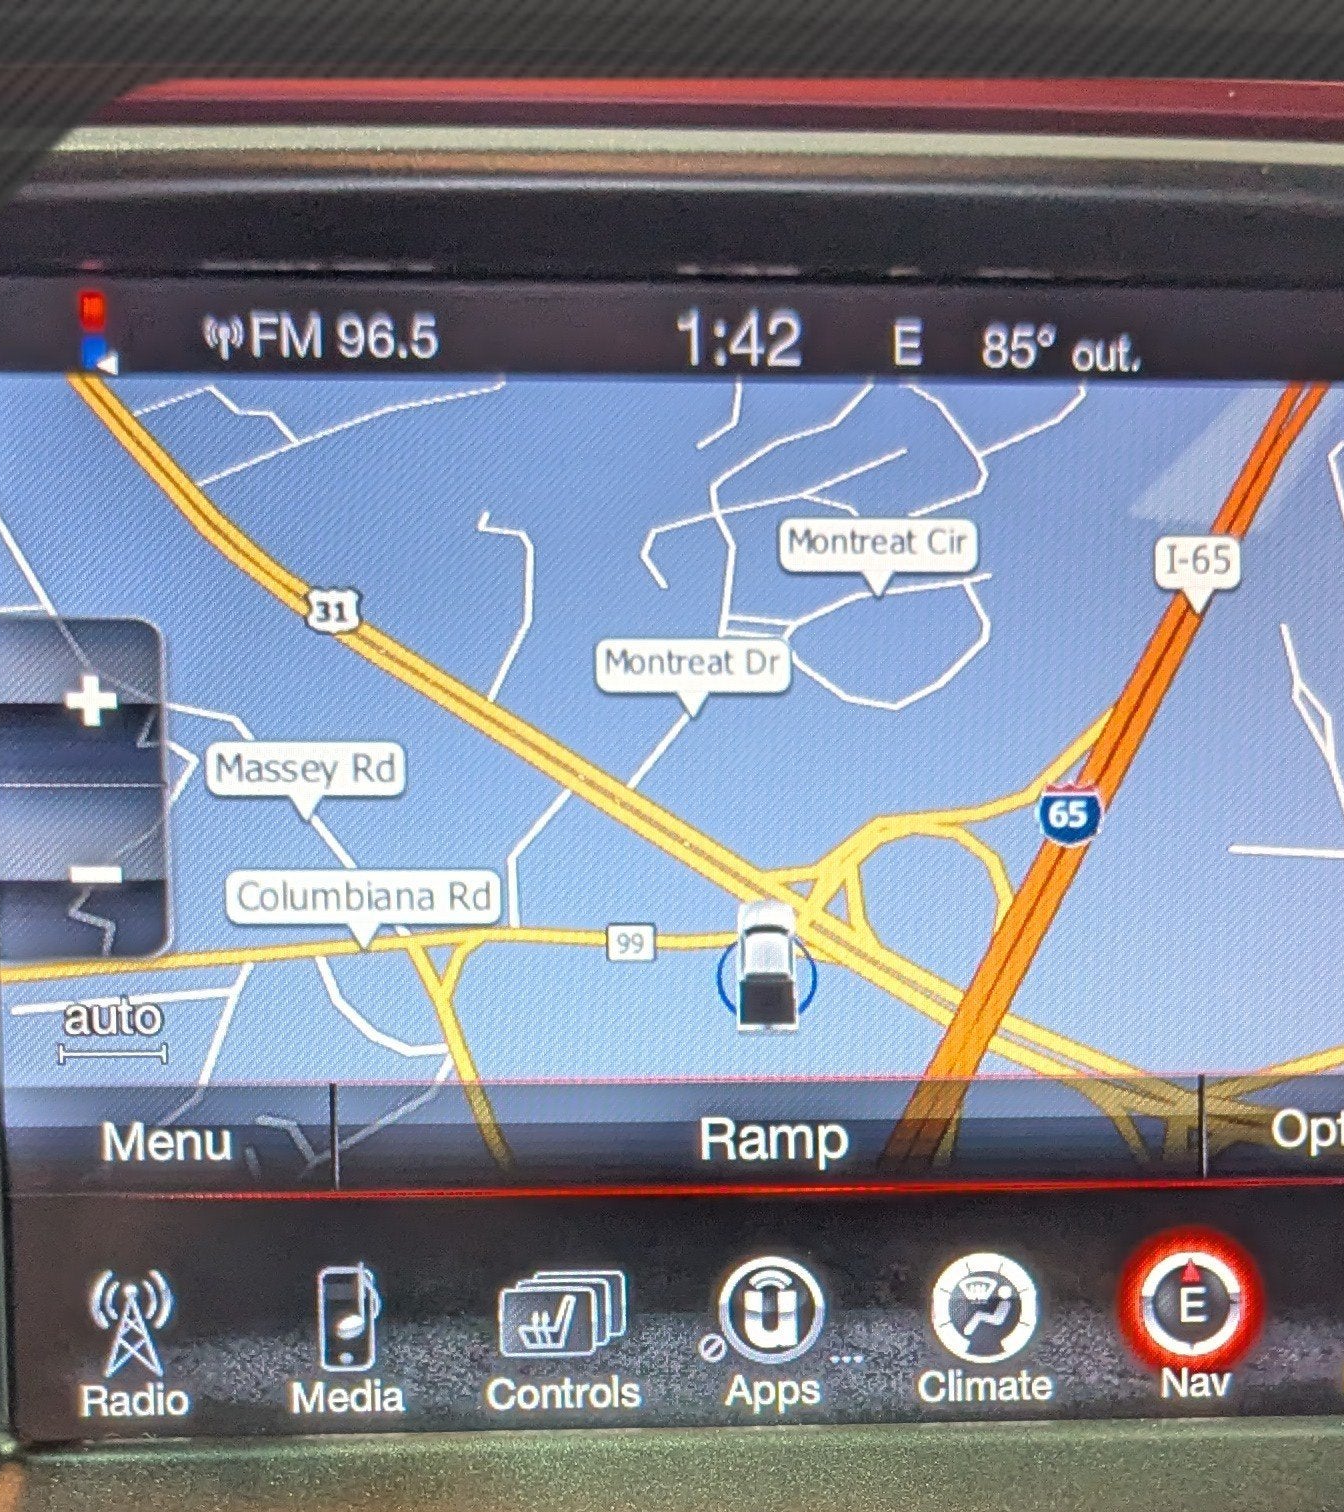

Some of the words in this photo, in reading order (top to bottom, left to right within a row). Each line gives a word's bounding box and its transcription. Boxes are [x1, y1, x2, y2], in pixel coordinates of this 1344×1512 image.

[251, 313, 322, 358] FM
[336, 312, 438, 360] 96.5
[677, 309, 802, 367] 1:42
[895, 320, 923, 365] E
[983, 324, 1056, 369] 85°
[1072, 335, 1141, 371] out.
[788, 527, 914, 555] Montreat
[928, 527, 967, 554] Cir
[1167, 544, 1231, 575] I-65
[317, 601, 348, 622] 31
[605, 648, 733, 676] Montreat
[746, 649, 780, 674] Dr
[217, 754, 336, 790] Massey
[349, 752, 395, 781] Rd
[1050, 800, 1087, 827] 65
[236, 881, 435, 914] Columbiana
[448, 881, 491, 911] Rd
[616, 932, 645, 955] 99
[65, 998, 162, 1035] auto
[103, 1122, 231, 1161] Menu
[700, 1117, 848, 1170] Ramp
[1181, 1287, 1207, 1322] E
[291, 1380, 403, 1413] Media
[487, 1376, 640, 1409] Controls
[727, 1375, 821, 1409] Apps
[920, 1370, 1052, 1403] Climate
[1161, 1367, 1231, 1397] Nav
[82, 1385, 189, 1416] Radio
